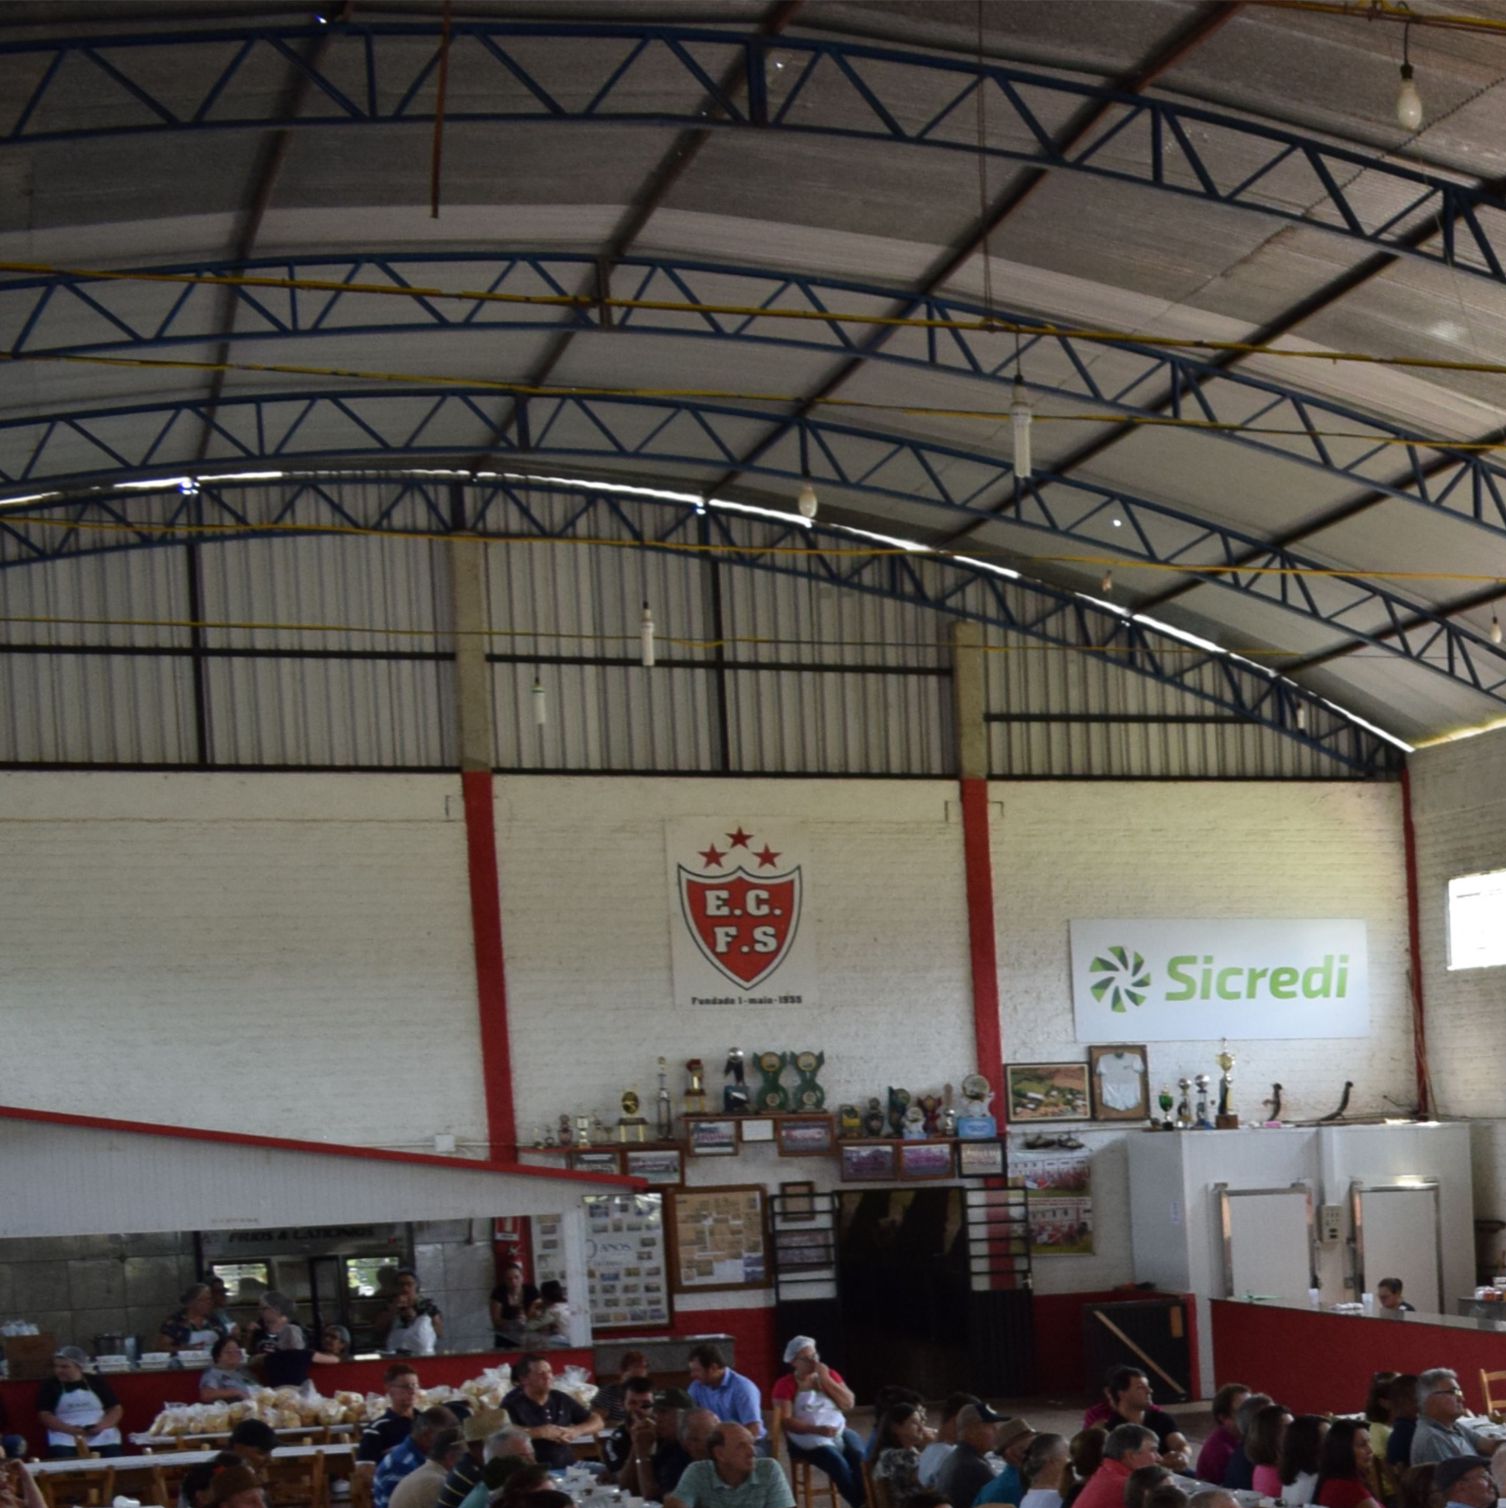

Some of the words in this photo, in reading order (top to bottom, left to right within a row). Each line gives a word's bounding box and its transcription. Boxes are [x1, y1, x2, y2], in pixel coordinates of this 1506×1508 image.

[705, 889, 783, 916] E.C.
[714, 926, 778, 953] F.S
[1165, 954, 1349, 1001] Sicredi
